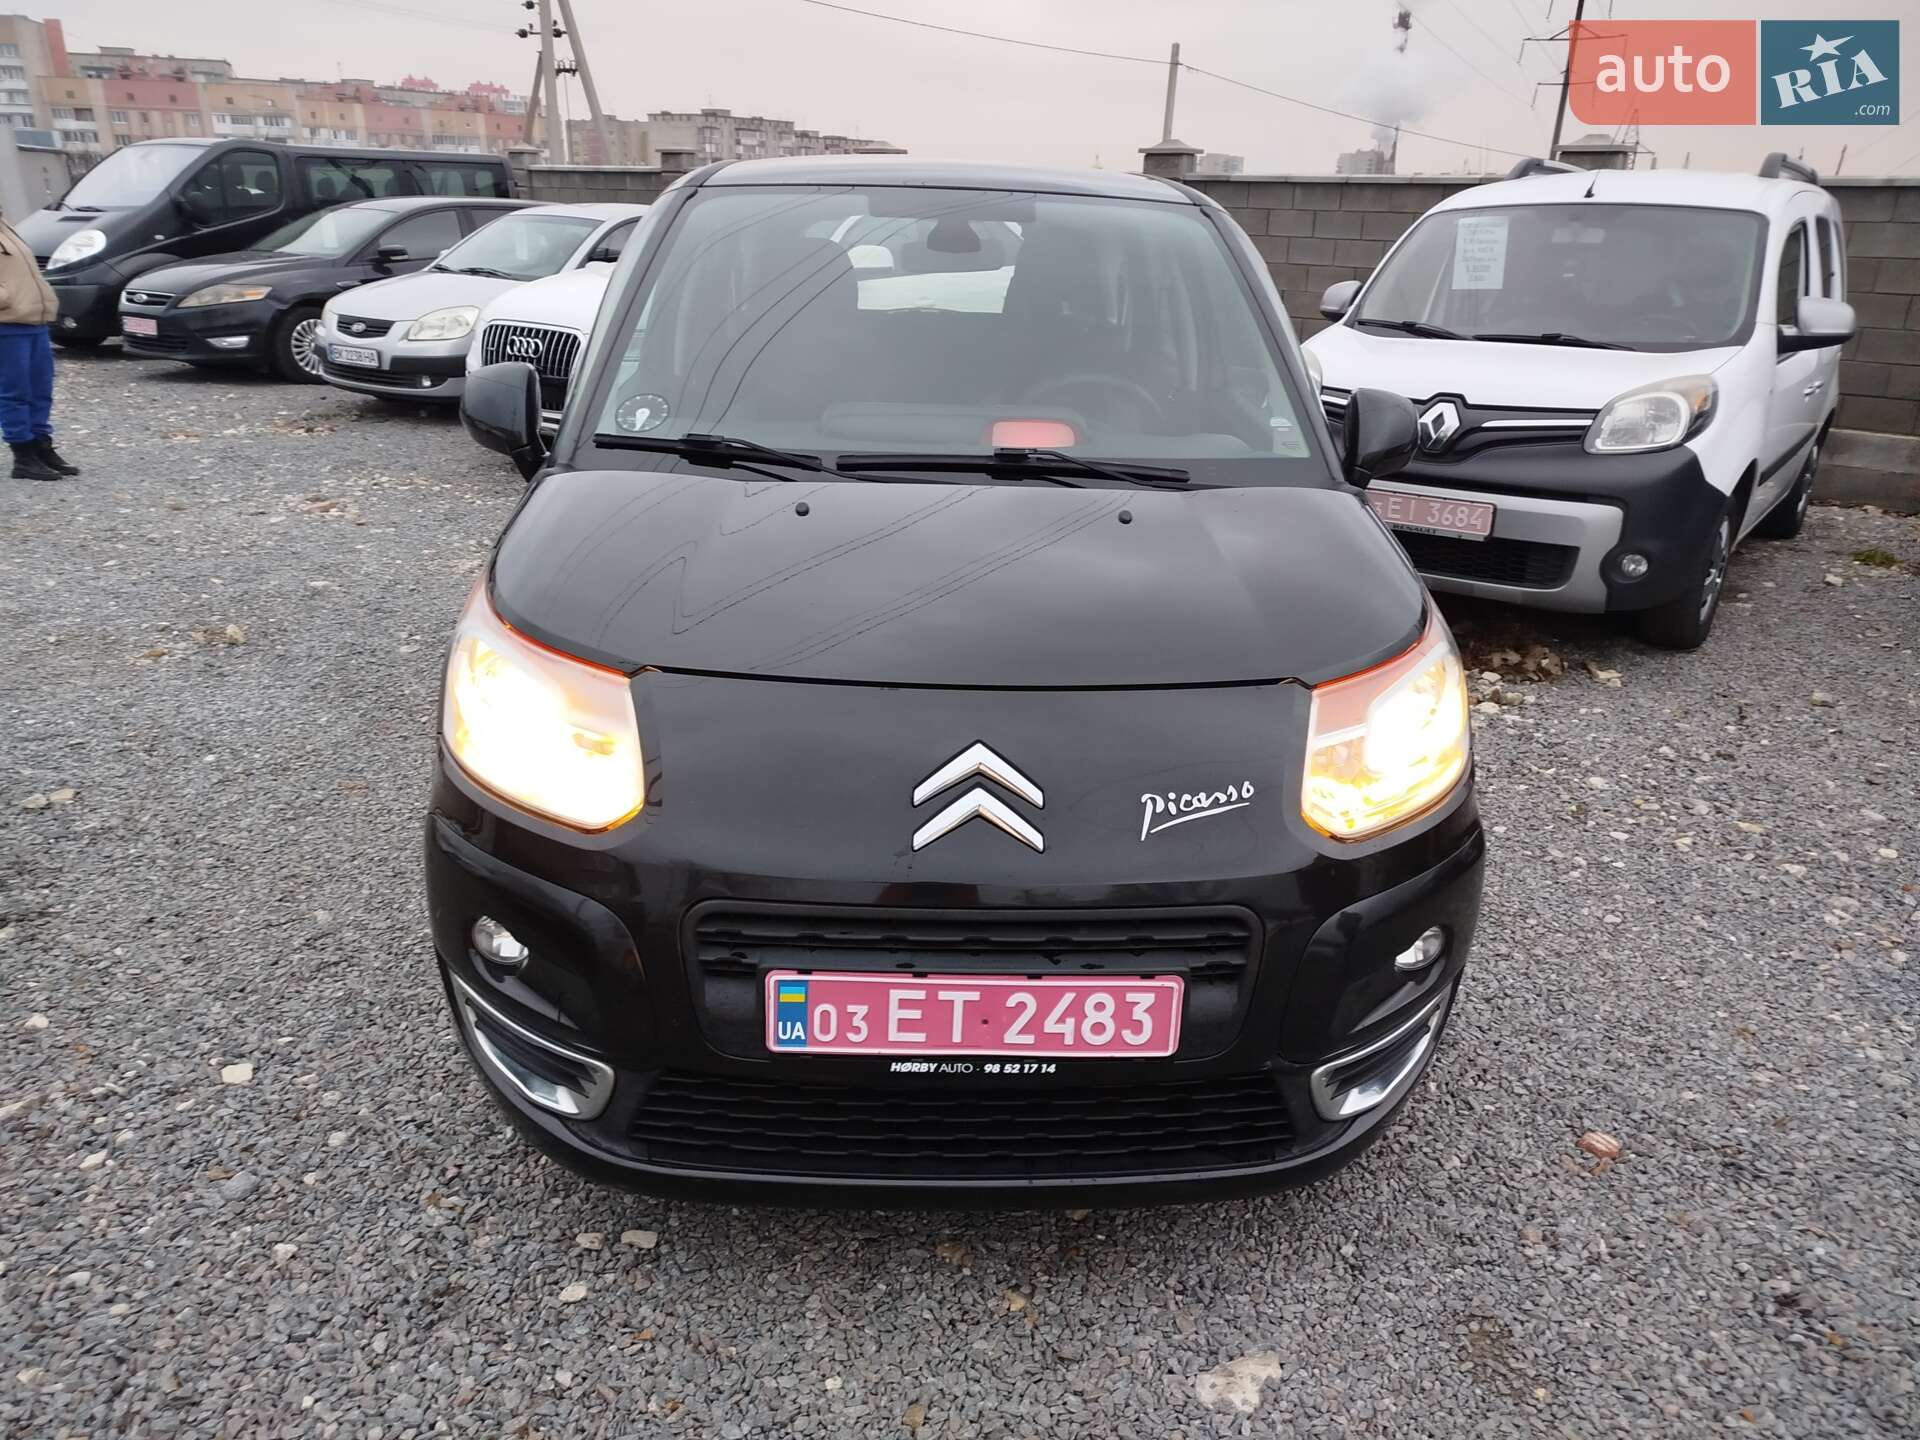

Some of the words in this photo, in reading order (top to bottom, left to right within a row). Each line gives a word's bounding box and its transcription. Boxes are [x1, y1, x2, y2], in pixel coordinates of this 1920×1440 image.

[1426, 502, 1485, 529] 3684
[813, 1003, 869, 1043] 03
[887, 989, 981, 1044] ET
[1003, 992, 1155, 1046] 2483
[777, 1021, 806, 1041] UA
[890, 1062, 938, 1074] HØRBY
[939, 1063, 974, 1074] AUTO
[983, 1063, 1001, 1074] 98
[1003, 1063, 1020, 1074] 52
[1023, 1063, 1038, 1074] 17
[1041, 1063, 1057, 1074] 14
